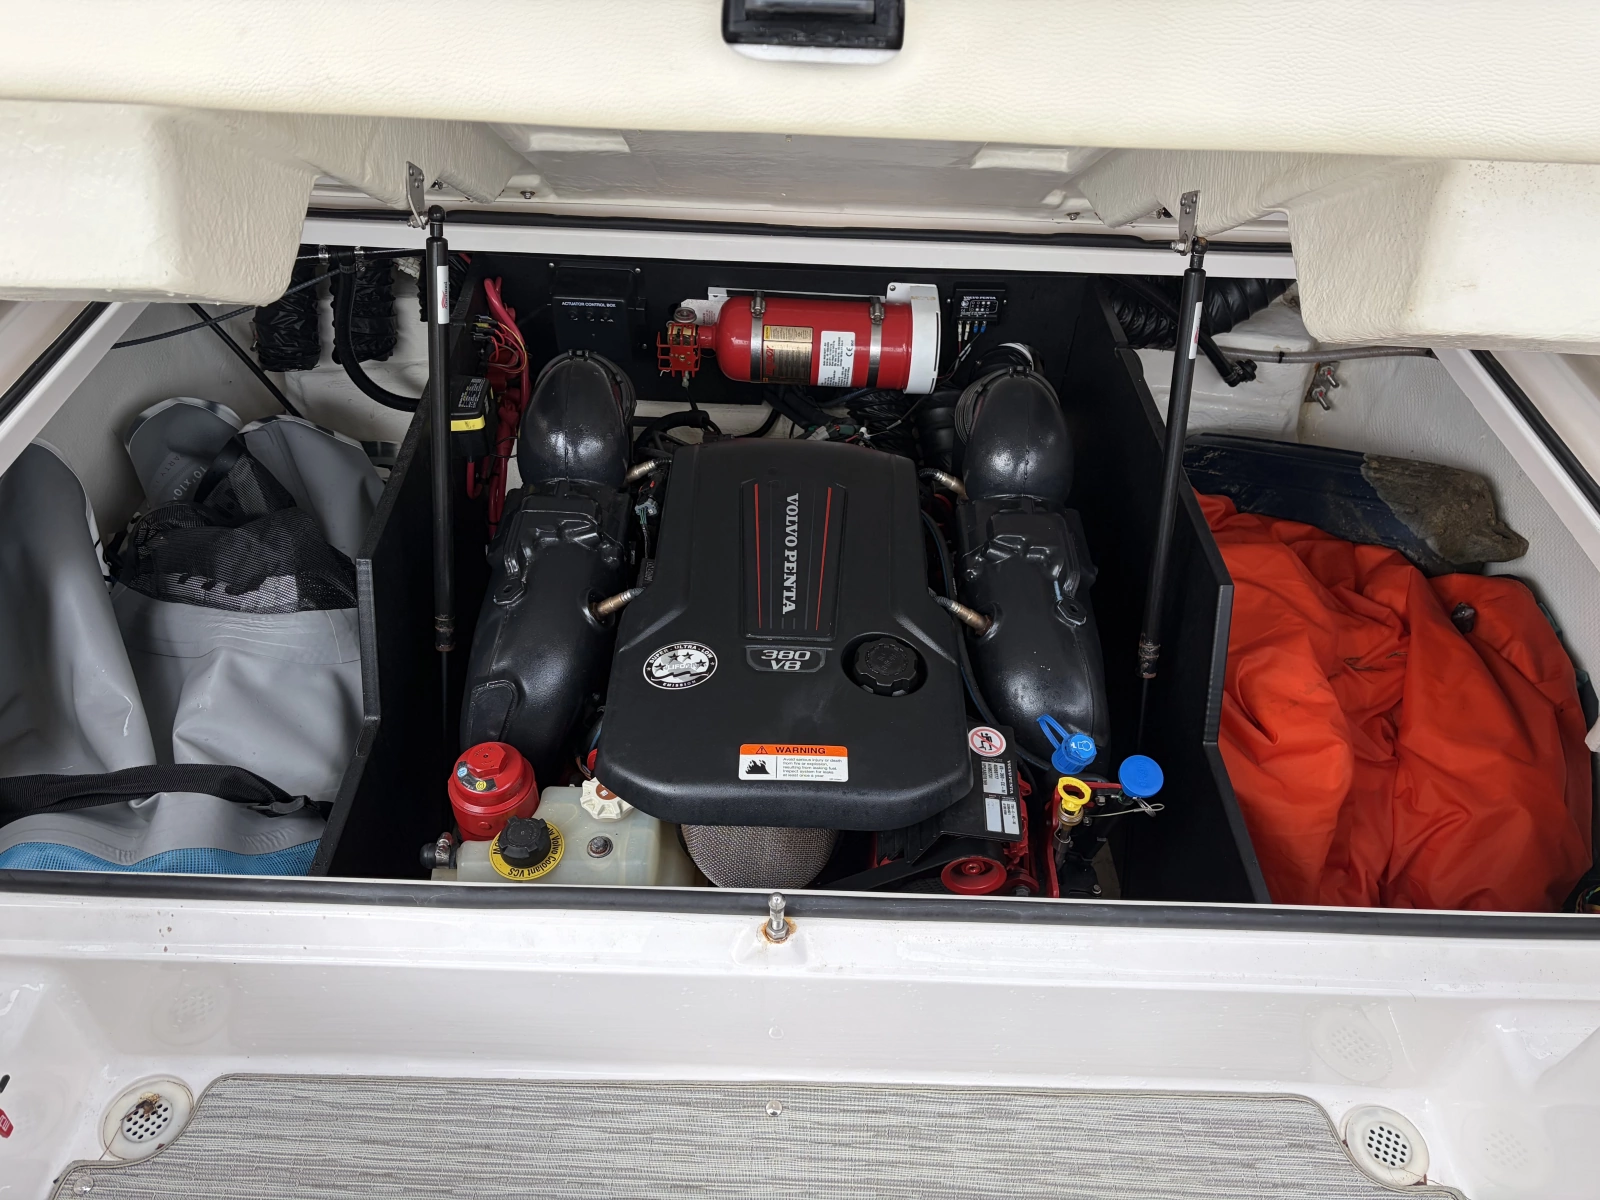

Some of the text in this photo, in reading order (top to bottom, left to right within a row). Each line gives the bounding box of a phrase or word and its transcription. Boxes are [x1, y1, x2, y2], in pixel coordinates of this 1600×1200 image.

[782, 493, 799, 615] VOLVO PENTA
[649, 648, 669, 664] SUPER
[701, 648, 714, 659] LOW
[761, 649, 811, 661] 380
[770, 660, 802, 671] V8
[662, 680, 697, 688] EMISSION
[775, 746, 826, 755] WARNING
[551, 836, 561, 855] Volvo
[508, 867, 525, 877] VCS
[527, 855, 557, 877] Coolant
